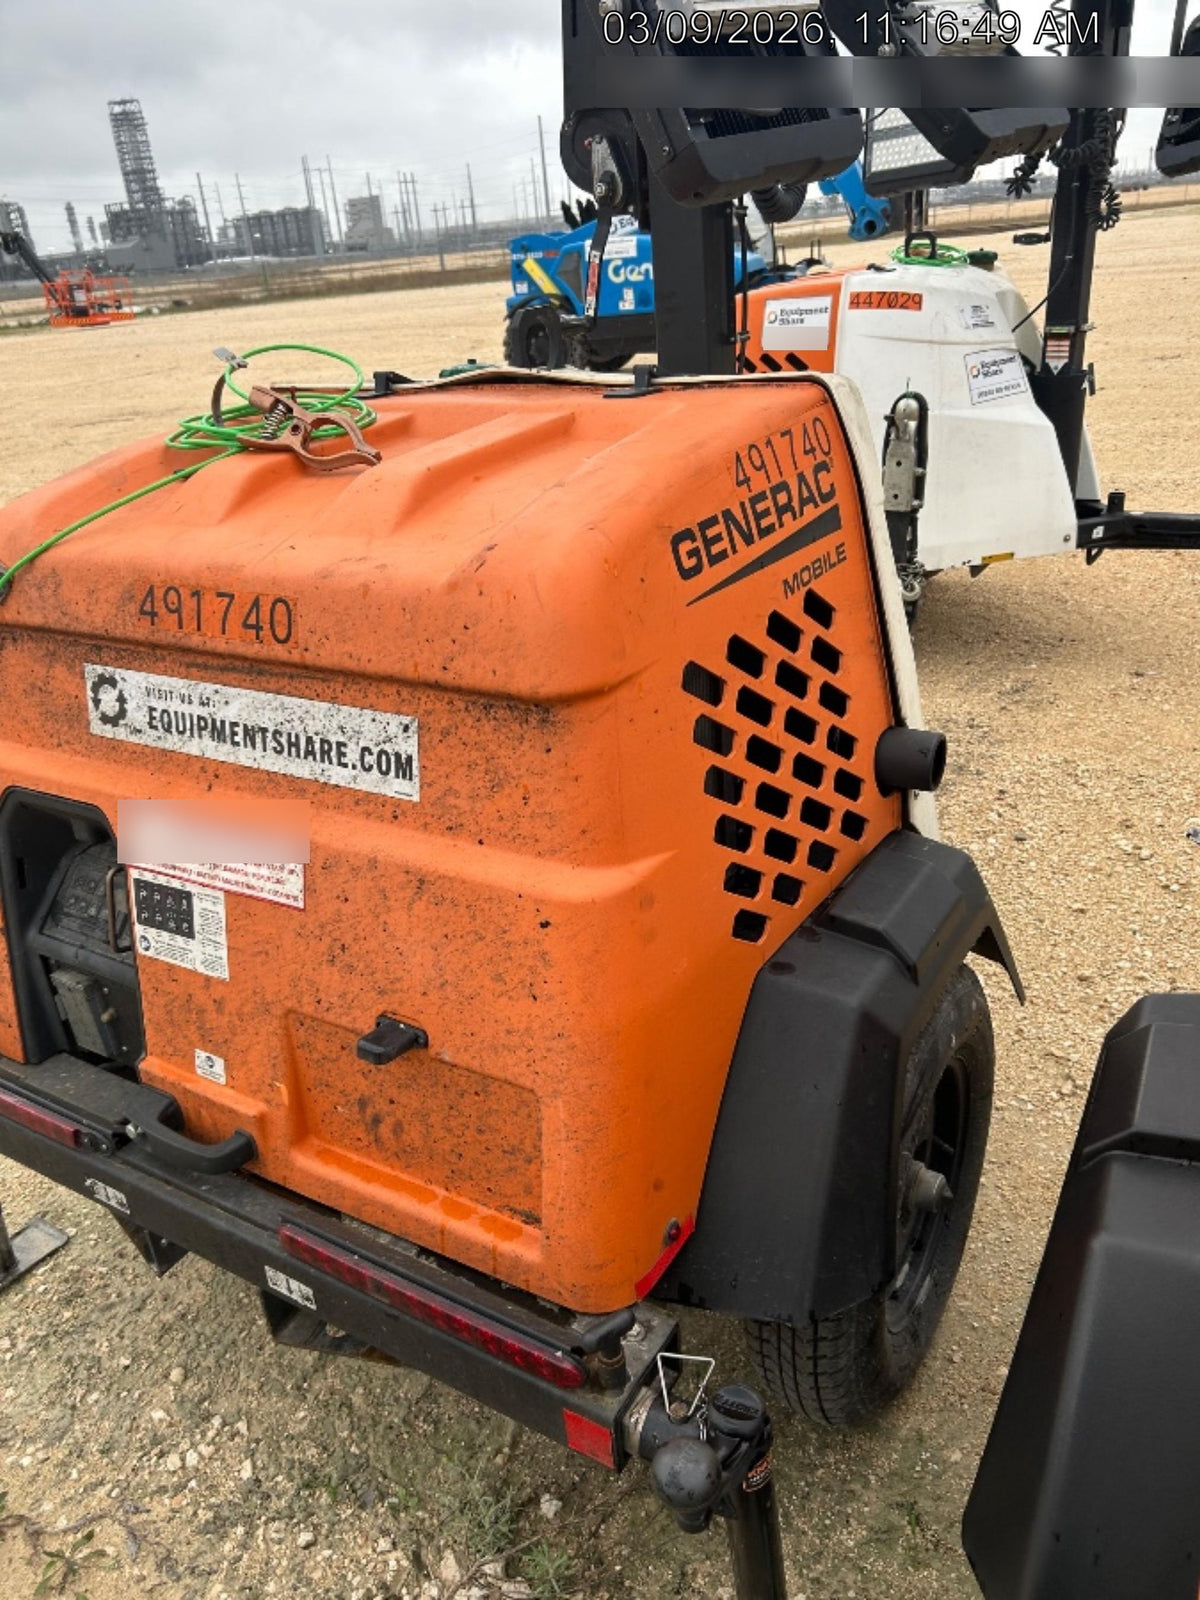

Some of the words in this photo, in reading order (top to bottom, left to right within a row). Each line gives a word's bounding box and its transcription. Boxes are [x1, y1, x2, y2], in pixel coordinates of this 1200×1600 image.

[850, 291, 923, 311] 447029
[735, 416, 831, 493] 491740
[670, 459, 836, 581] GENERAC
[782, 542, 847, 600] MOBILE
[139, 584, 292, 644] 491740
[145, 686, 174, 702] VISIT
[148, 705, 414, 781] EQUIPMENTSHARE.COM
